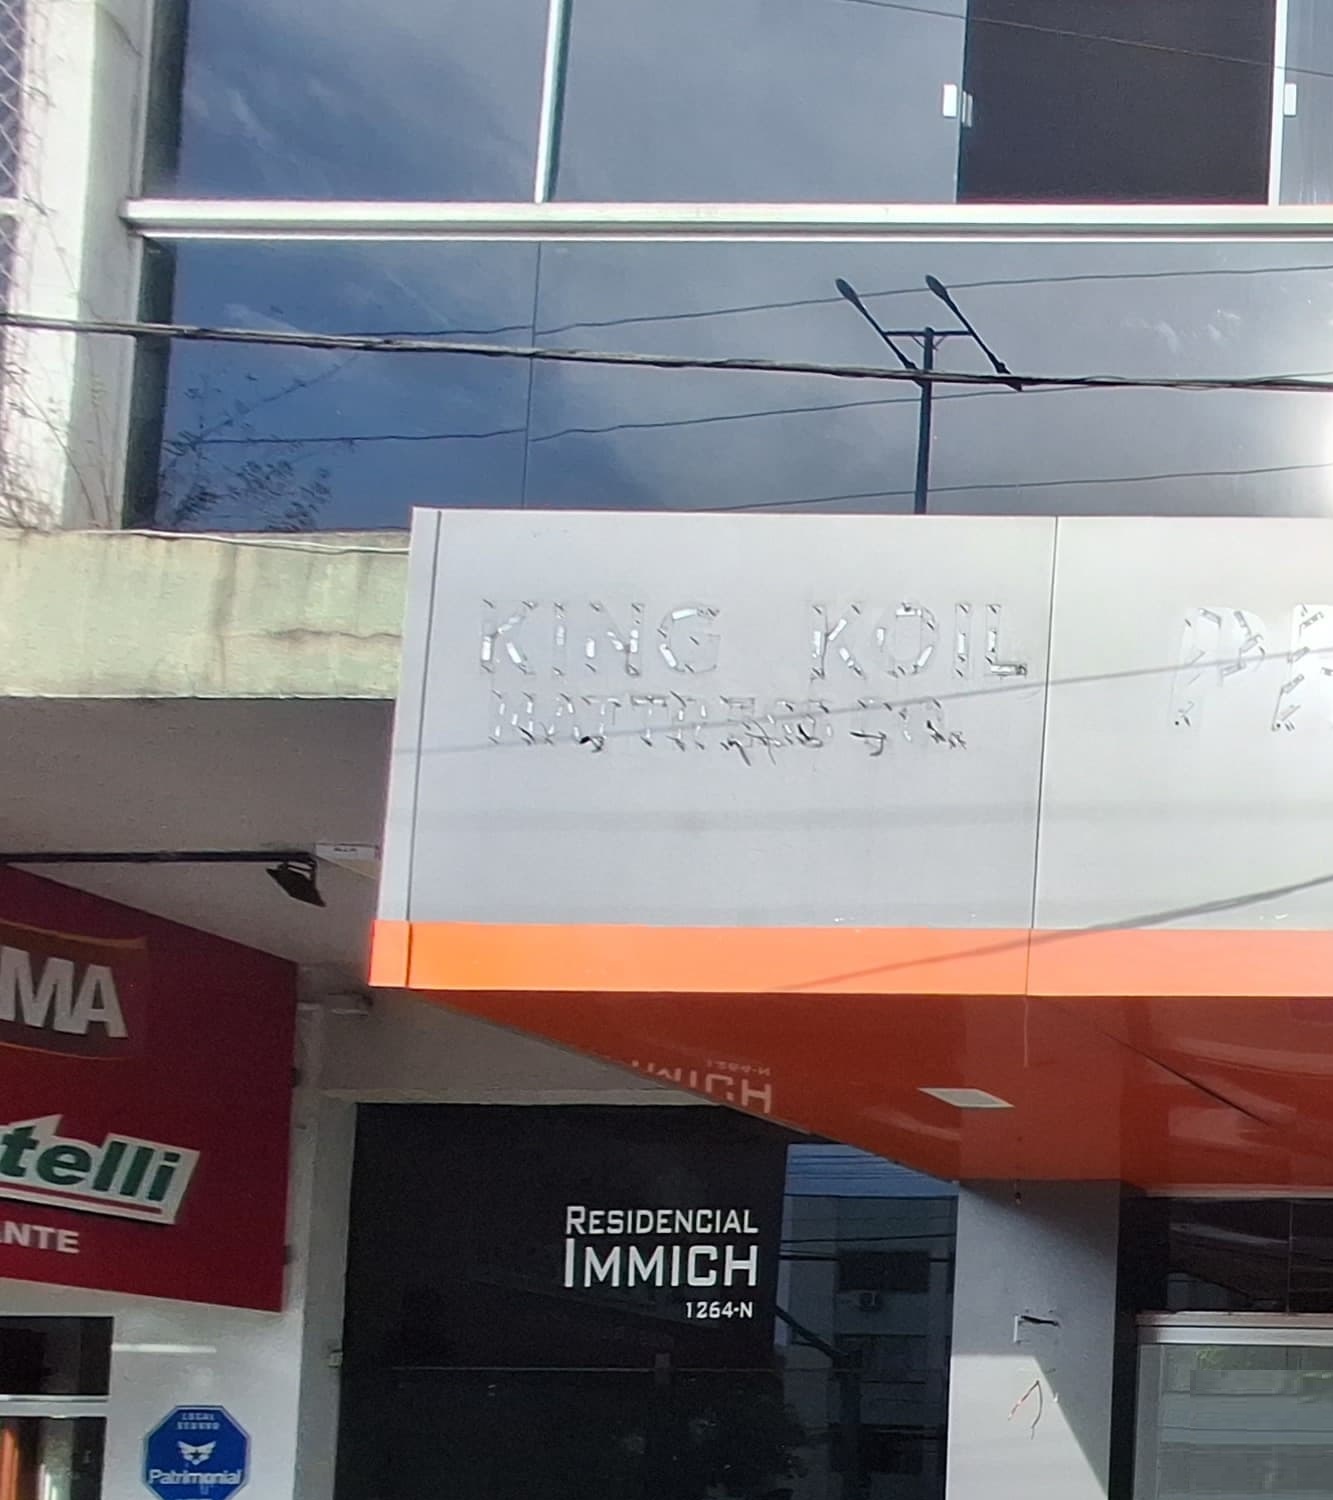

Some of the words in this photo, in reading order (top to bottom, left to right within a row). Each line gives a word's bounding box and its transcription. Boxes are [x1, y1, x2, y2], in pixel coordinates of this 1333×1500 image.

[566, 1206, 759, 1235] RESIDENCIAL
[0, 1220, 80, 1254] NTE
[564, 1238, 759, 1288] IMMICH
[685, 1301, 753, 1319] 1264-N
[148, 1468, 242, 1485] Patrimonial
